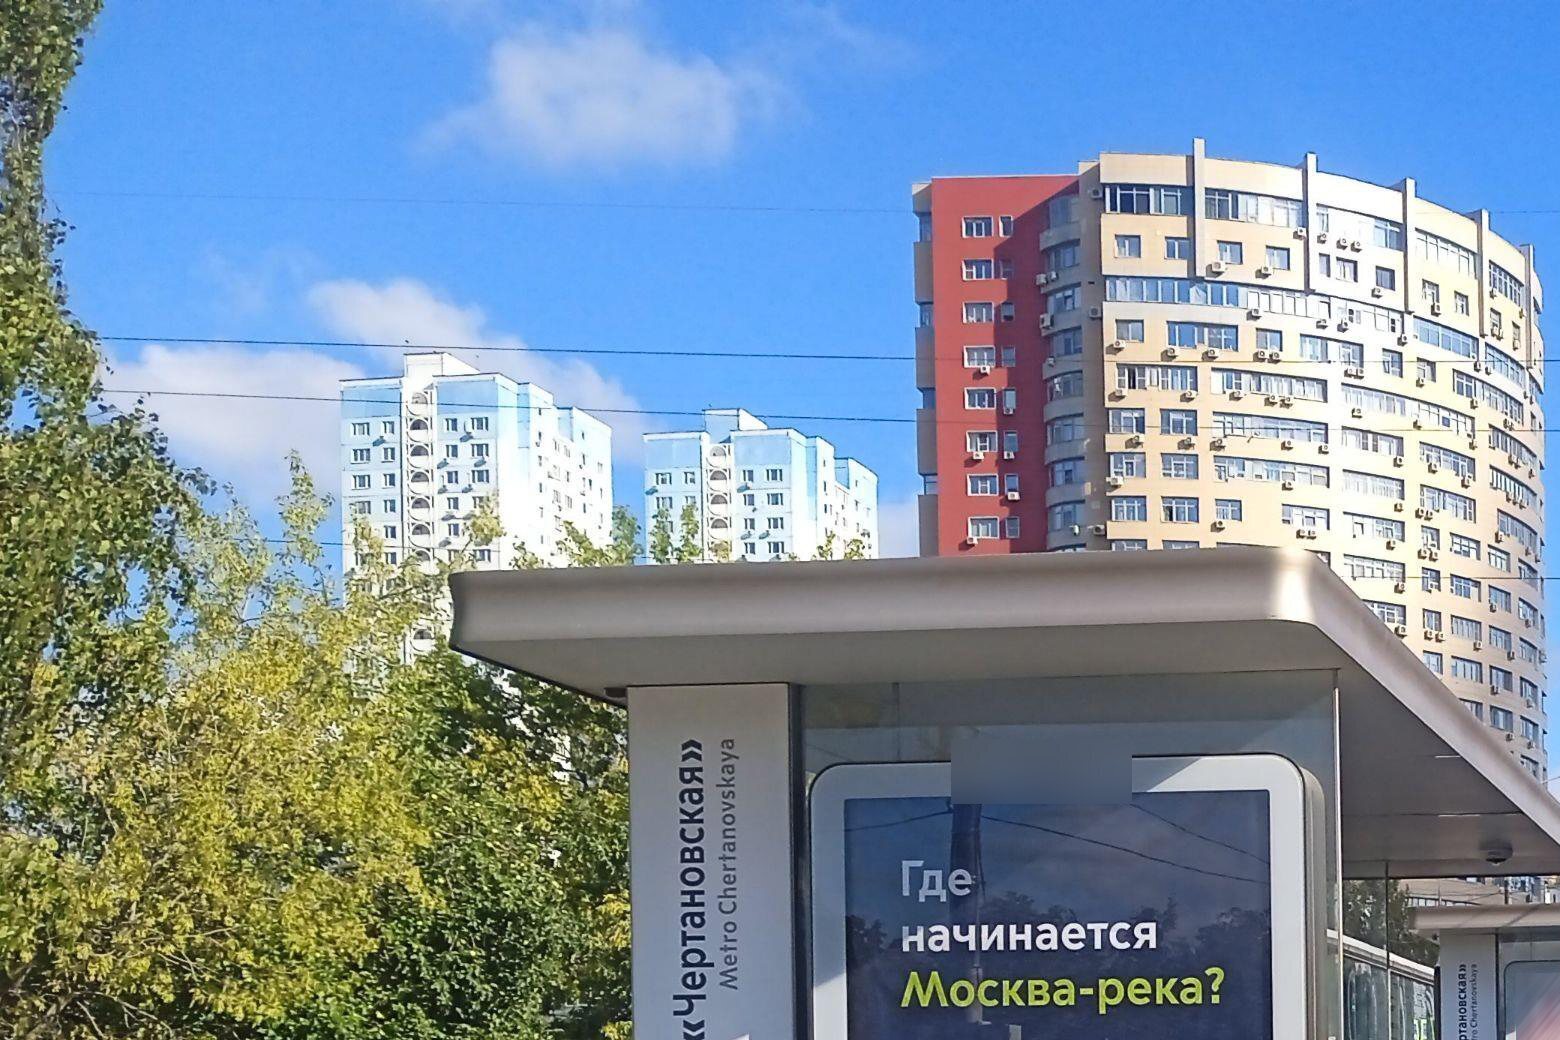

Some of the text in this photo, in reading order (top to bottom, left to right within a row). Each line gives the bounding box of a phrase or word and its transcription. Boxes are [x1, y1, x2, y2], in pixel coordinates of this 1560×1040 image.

[716, 738, 740, 990] Metro Chertanovskaya
[901, 860, 973, 902] Где
[901, 921, 1158, 953] начинается
[901, 967, 1226, 1015] Москва-река?
